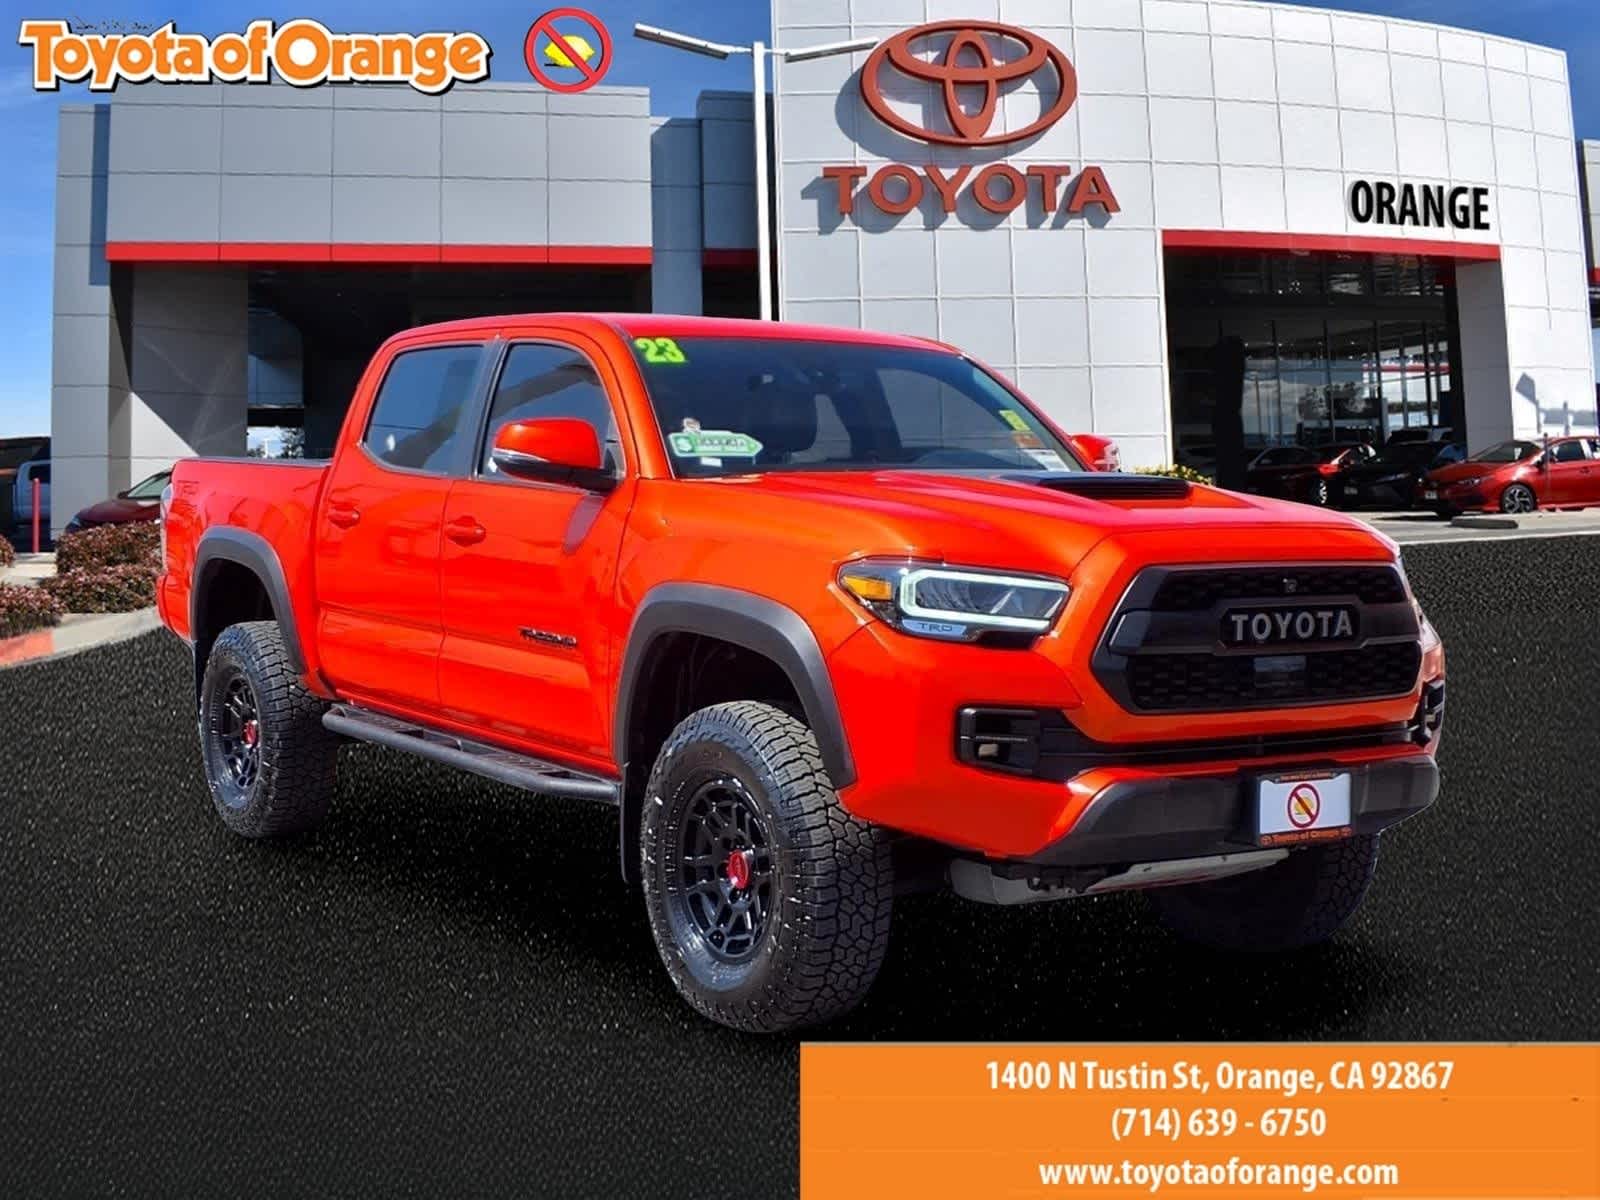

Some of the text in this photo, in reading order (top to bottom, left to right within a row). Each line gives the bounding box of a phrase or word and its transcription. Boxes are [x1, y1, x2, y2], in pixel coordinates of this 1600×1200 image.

[822, 163, 1121, 216] TOYOTA
[1349, 179, 1491, 231] ORANGE
[633, 336, 687, 364] 23
[917, 621, 954, 633] TRD
[1231, 609, 1353, 642] TOYOTA
